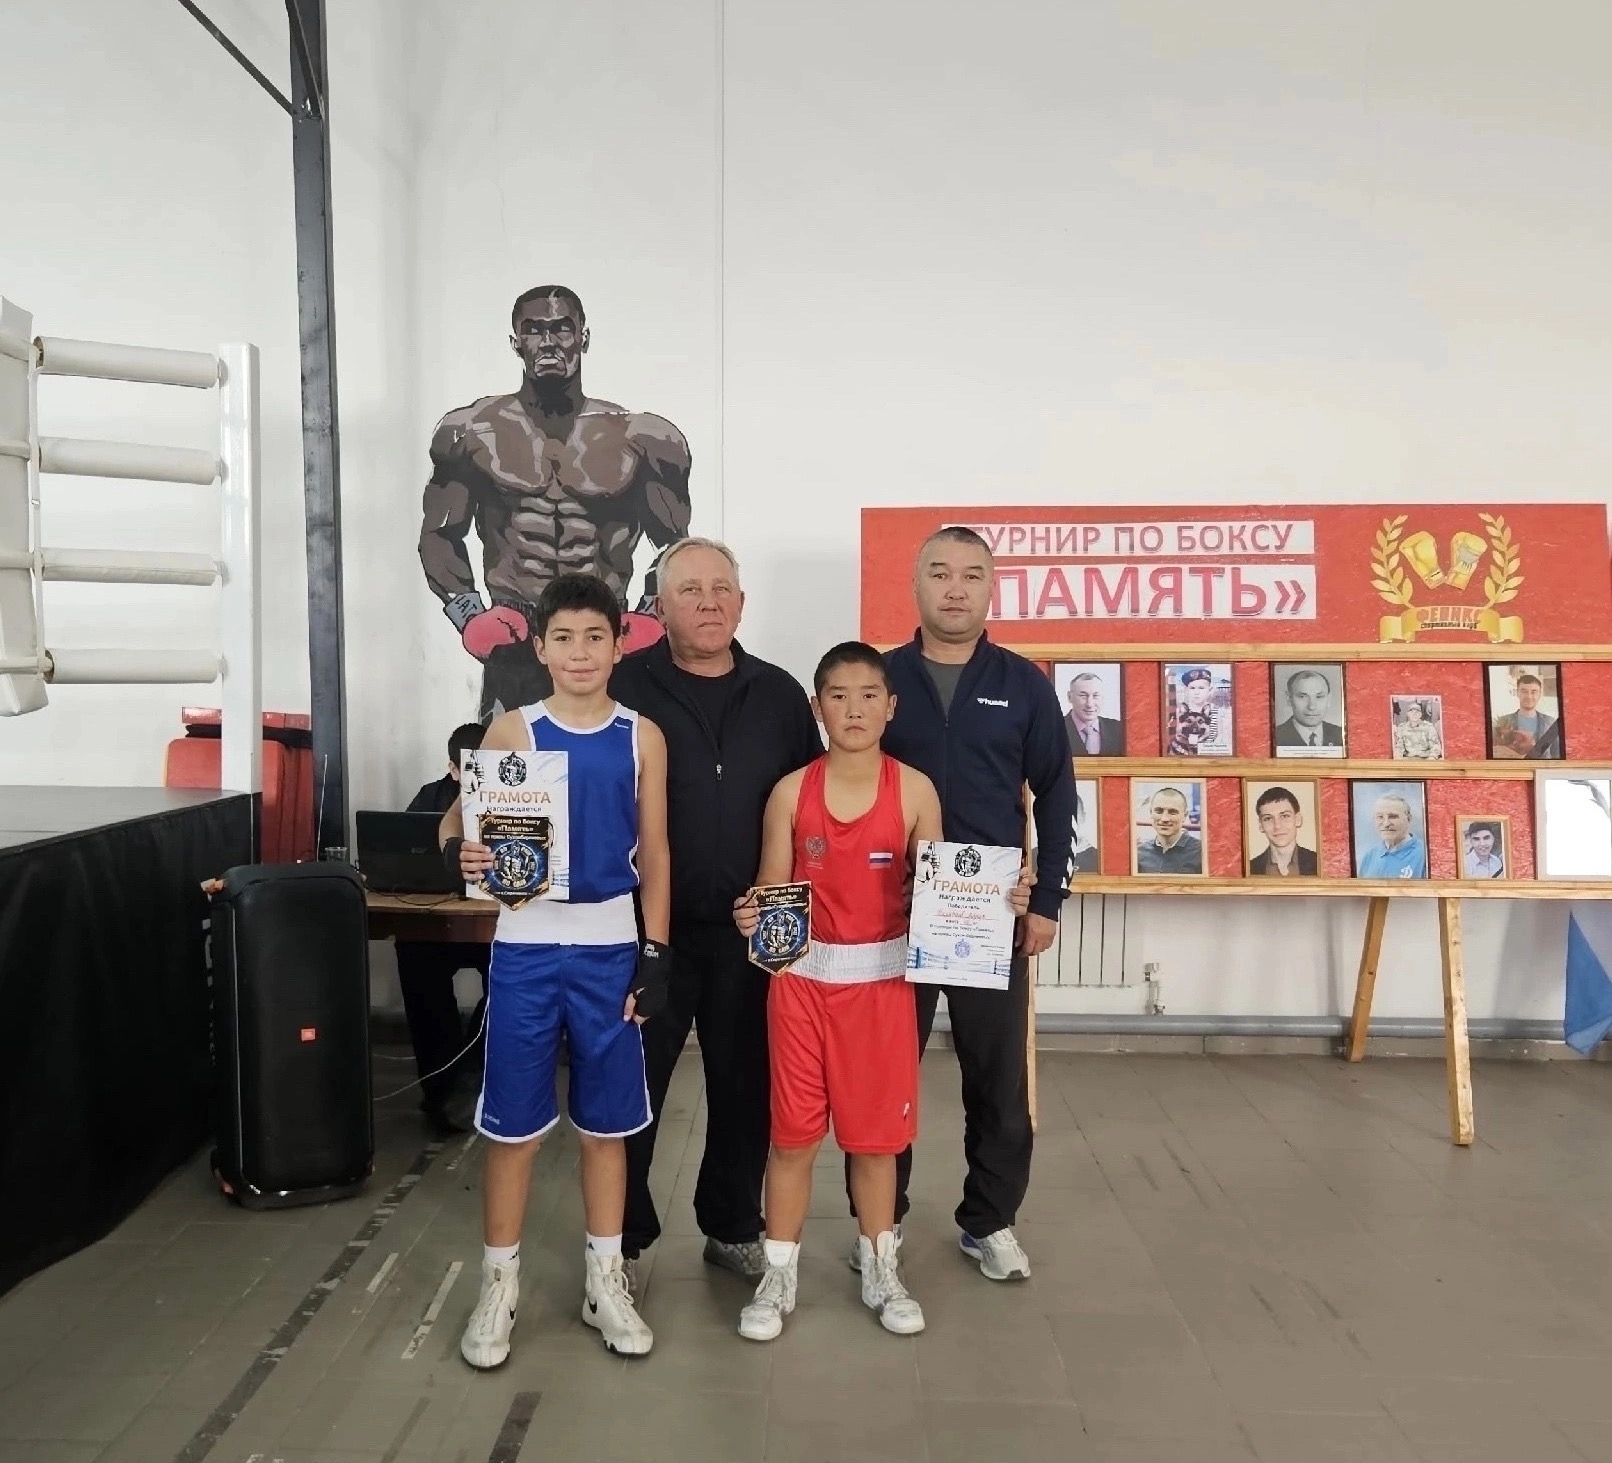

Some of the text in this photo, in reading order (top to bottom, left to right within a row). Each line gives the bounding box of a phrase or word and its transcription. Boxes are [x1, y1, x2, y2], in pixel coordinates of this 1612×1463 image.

[1114, 525, 1164, 553] ПО
[1177, 524, 1293, 552] БОКСУ
[480, 791, 551, 803] ГРАМОТА
[933, 880, 1000, 895] ГРАМОТА
